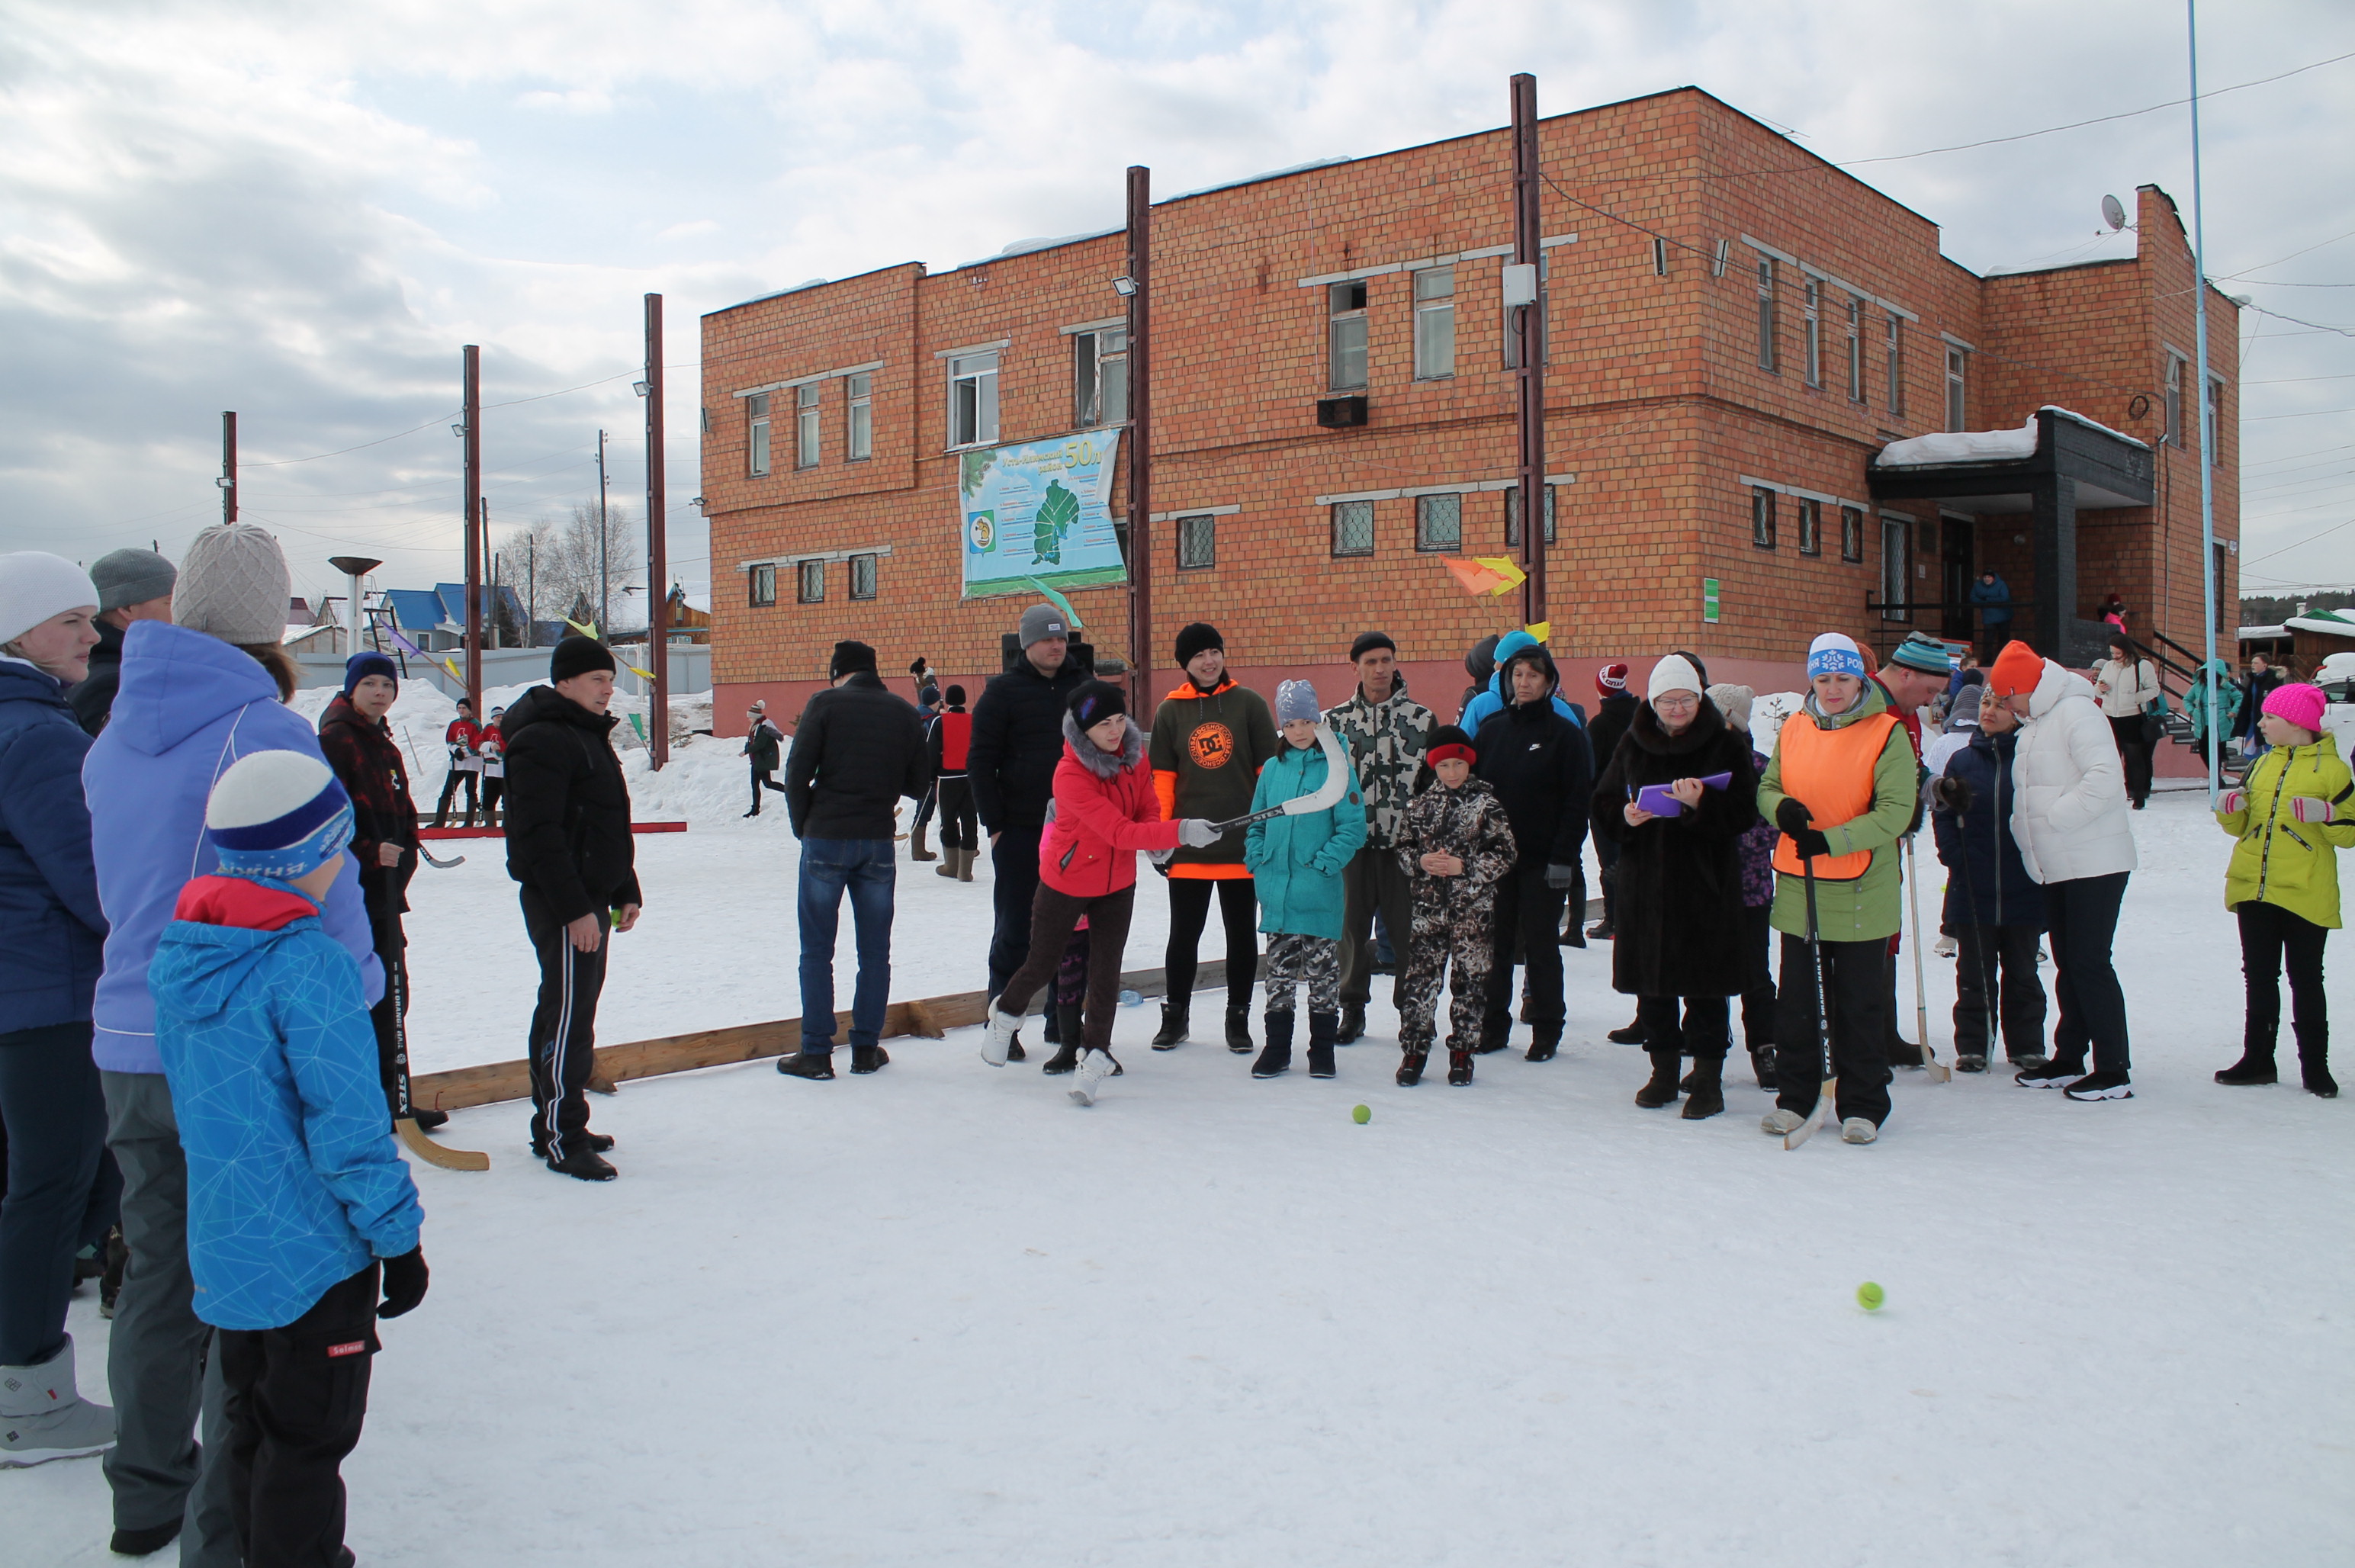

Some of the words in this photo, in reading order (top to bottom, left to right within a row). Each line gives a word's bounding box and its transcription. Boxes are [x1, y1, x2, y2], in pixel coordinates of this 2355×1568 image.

[1065, 440, 1092, 468] 50
[1091, 451, 1102, 464] л
[1253, 808, 1284, 822] STEX
[394, 995, 403, 1028] ORANGE
[398, 1074, 408, 1115] STEX
